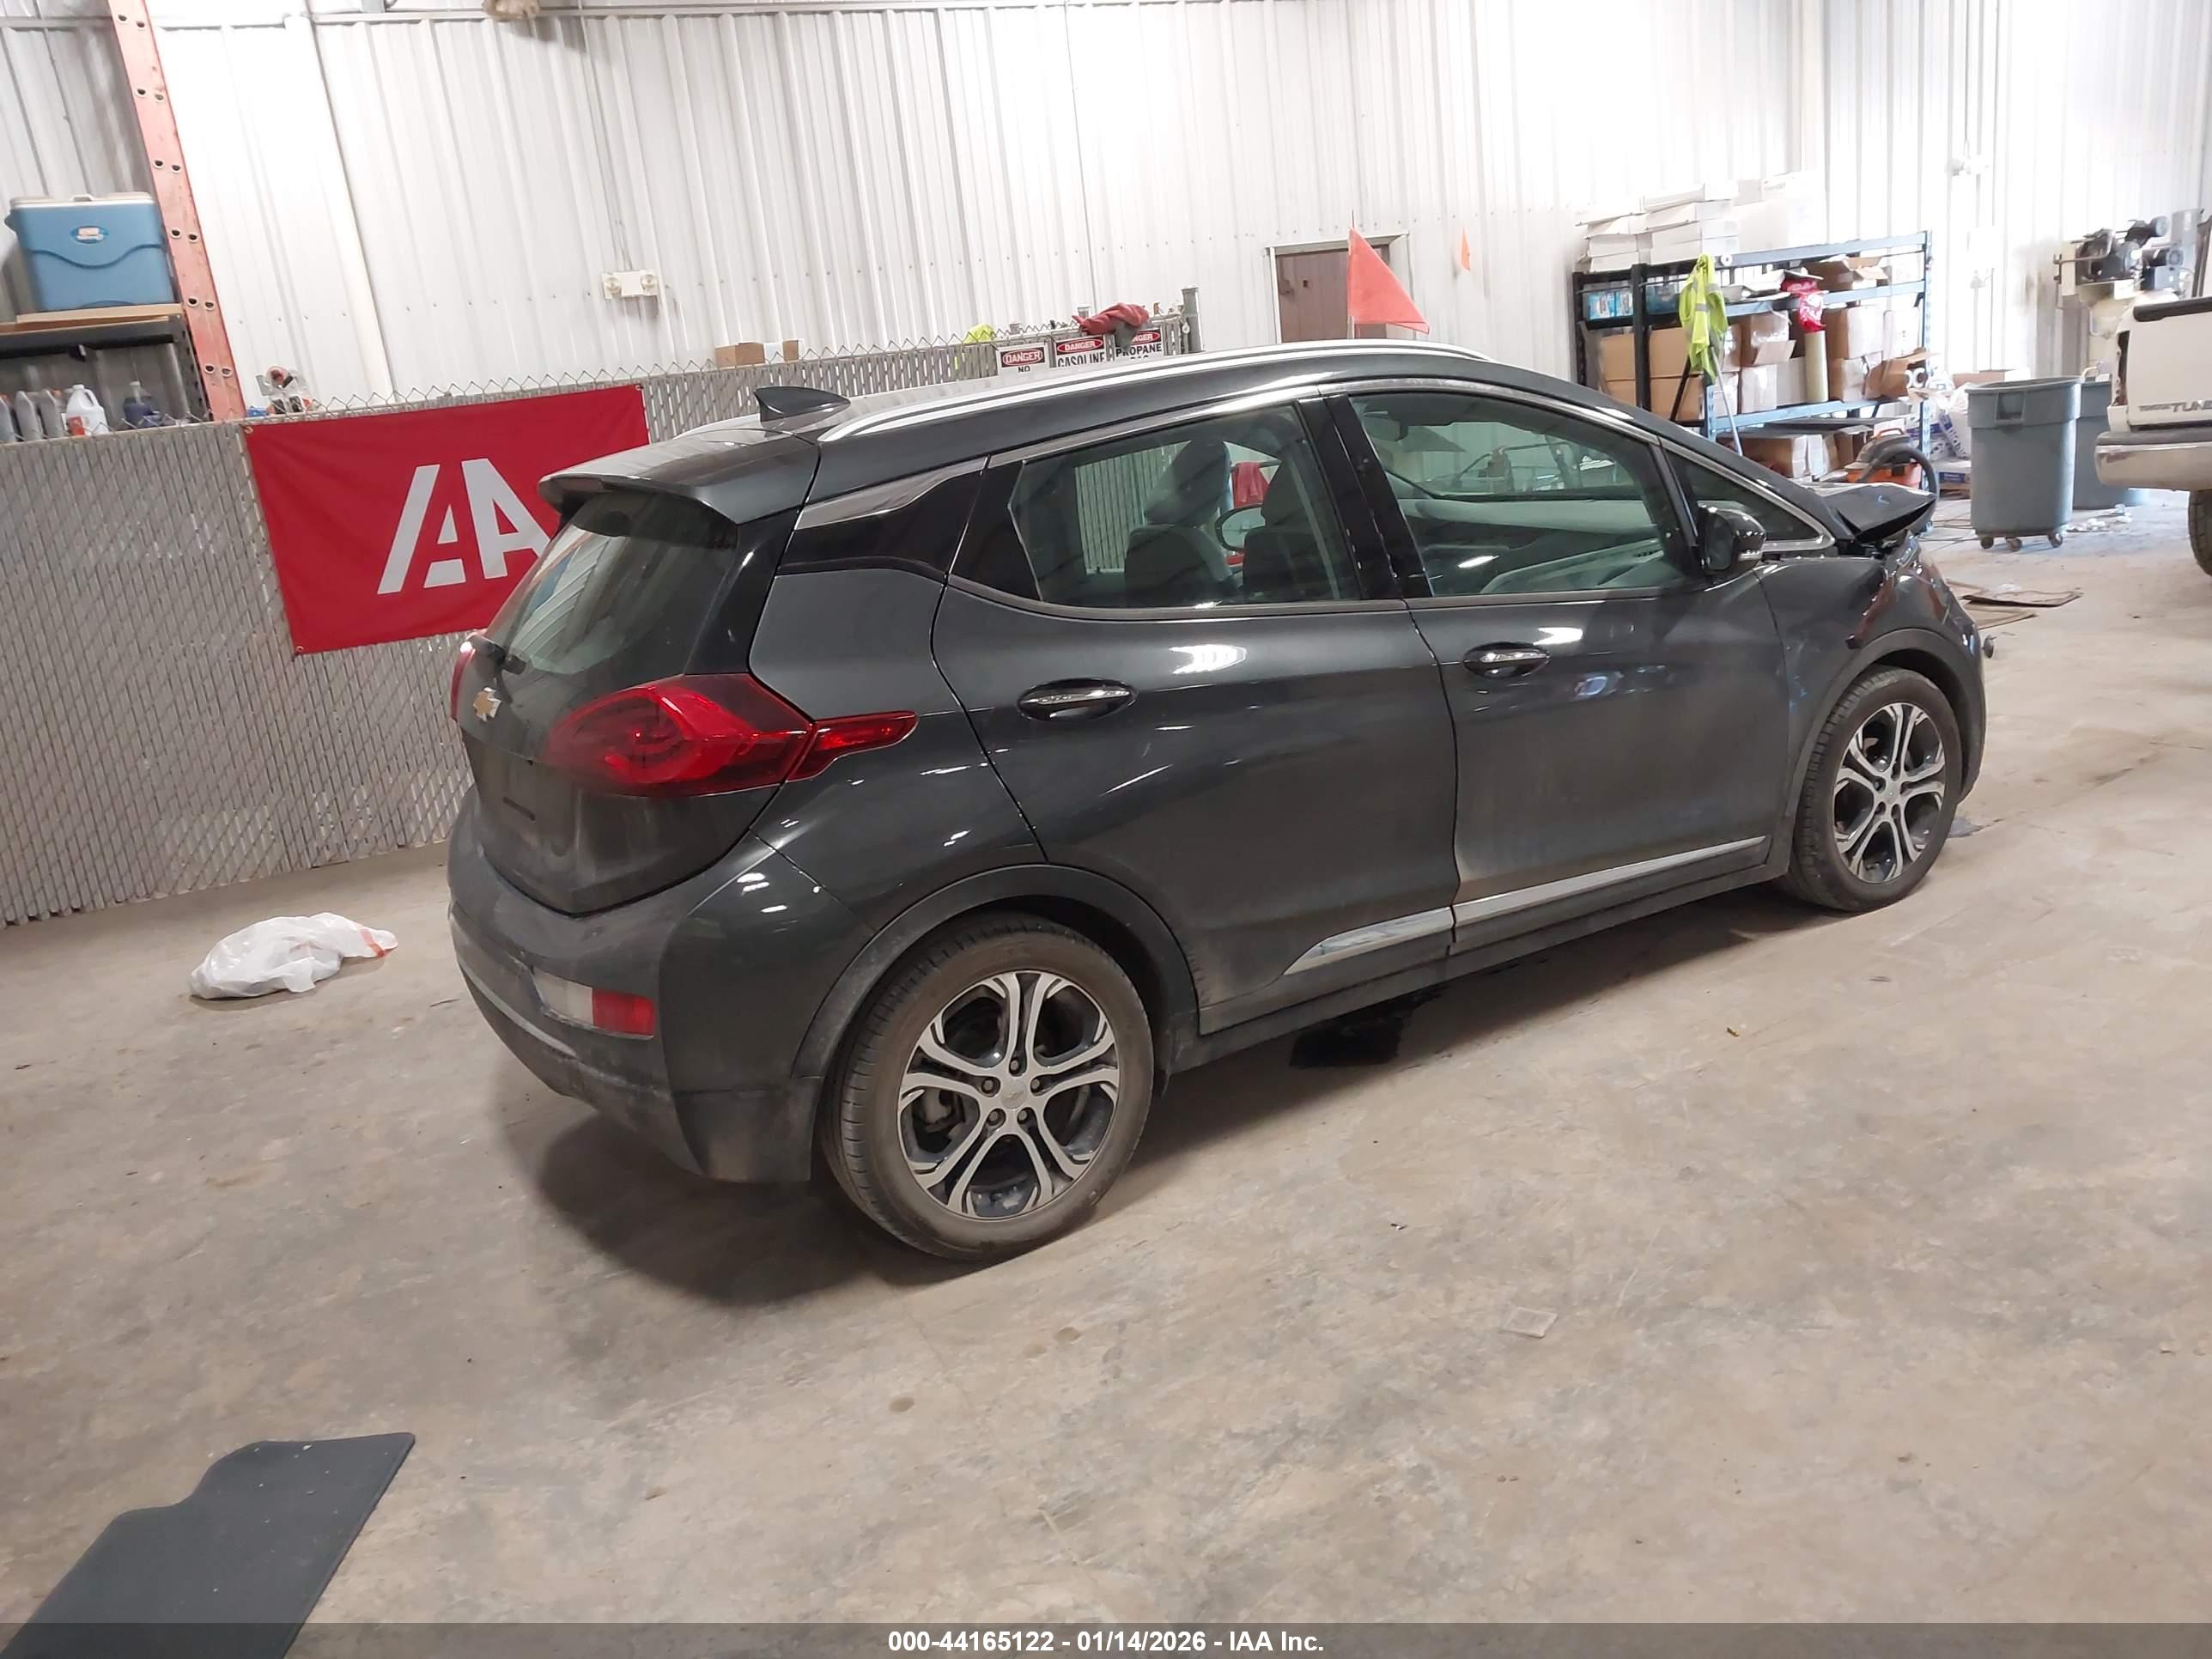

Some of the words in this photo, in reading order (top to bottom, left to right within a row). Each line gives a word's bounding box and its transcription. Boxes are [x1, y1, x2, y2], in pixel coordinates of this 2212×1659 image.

[1132, 333, 1154, 342] NGER
[1064, 341, 1096, 351] DANGER
[1005, 351, 1041, 362] DANGER
